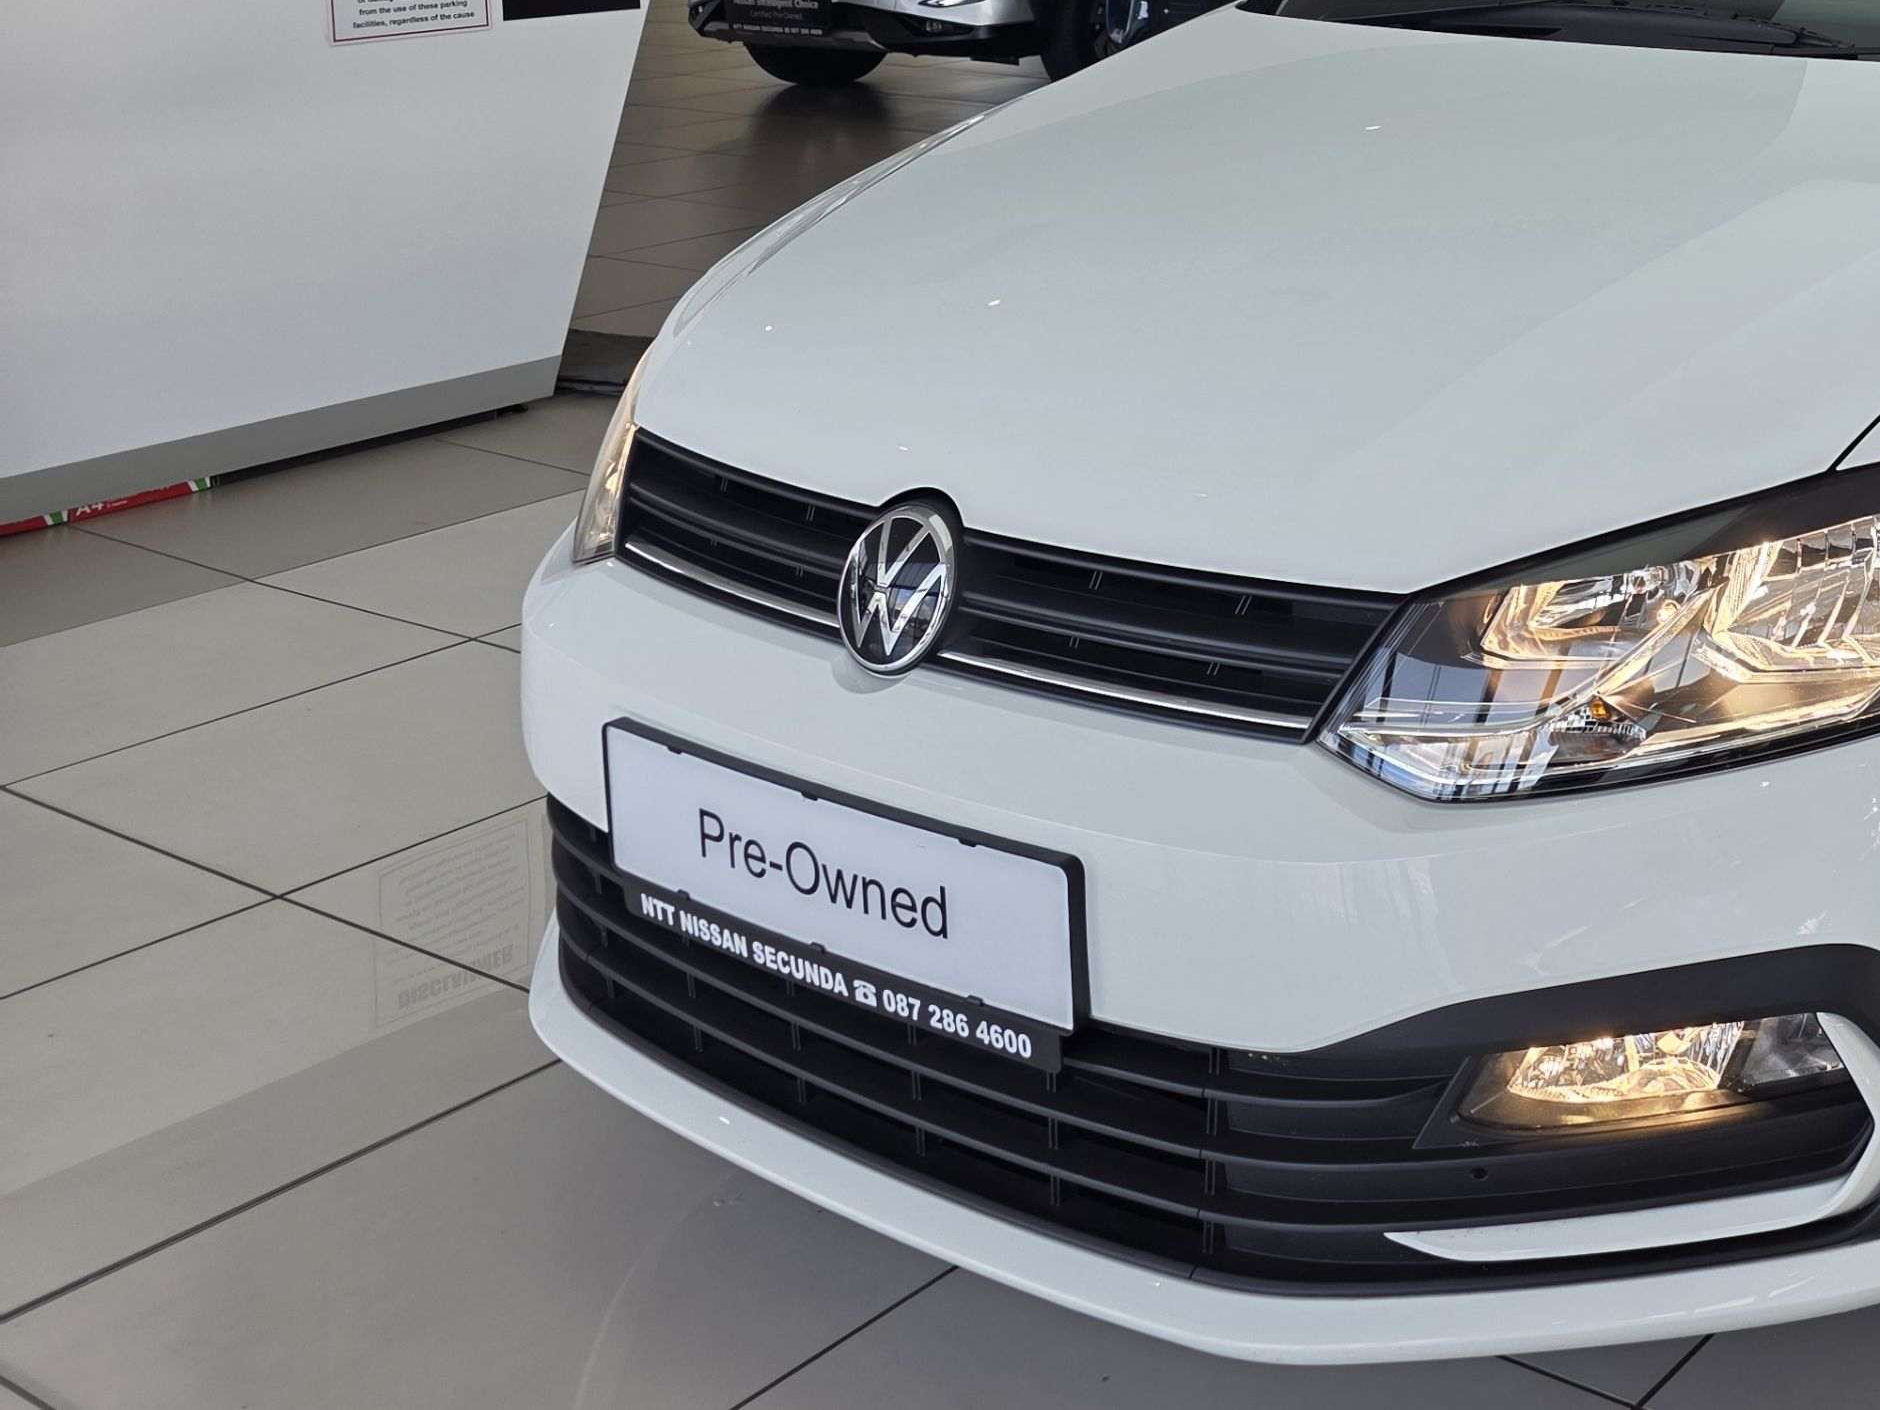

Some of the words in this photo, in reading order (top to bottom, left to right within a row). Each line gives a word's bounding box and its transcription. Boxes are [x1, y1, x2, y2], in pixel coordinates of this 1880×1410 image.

[359, 8, 377, 16] from
[379, 6, 391, 14] the
[418, 2, 438, 10] these
[440, 0, 468, 10] parking
[389, 16, 429, 26] regardless
[453, 11, 475, 19] cause
[699, 808, 949, 940] Pre-Owned
[641, 893, 676, 926] NTT
[680, 909, 748, 959] NISSAN
[752, 940, 849, 998] SECUNDA
[883, 990, 921, 1021] 087
[928, 1005, 969, 1038] 286
[975, 1021, 1033, 1059] 4600
